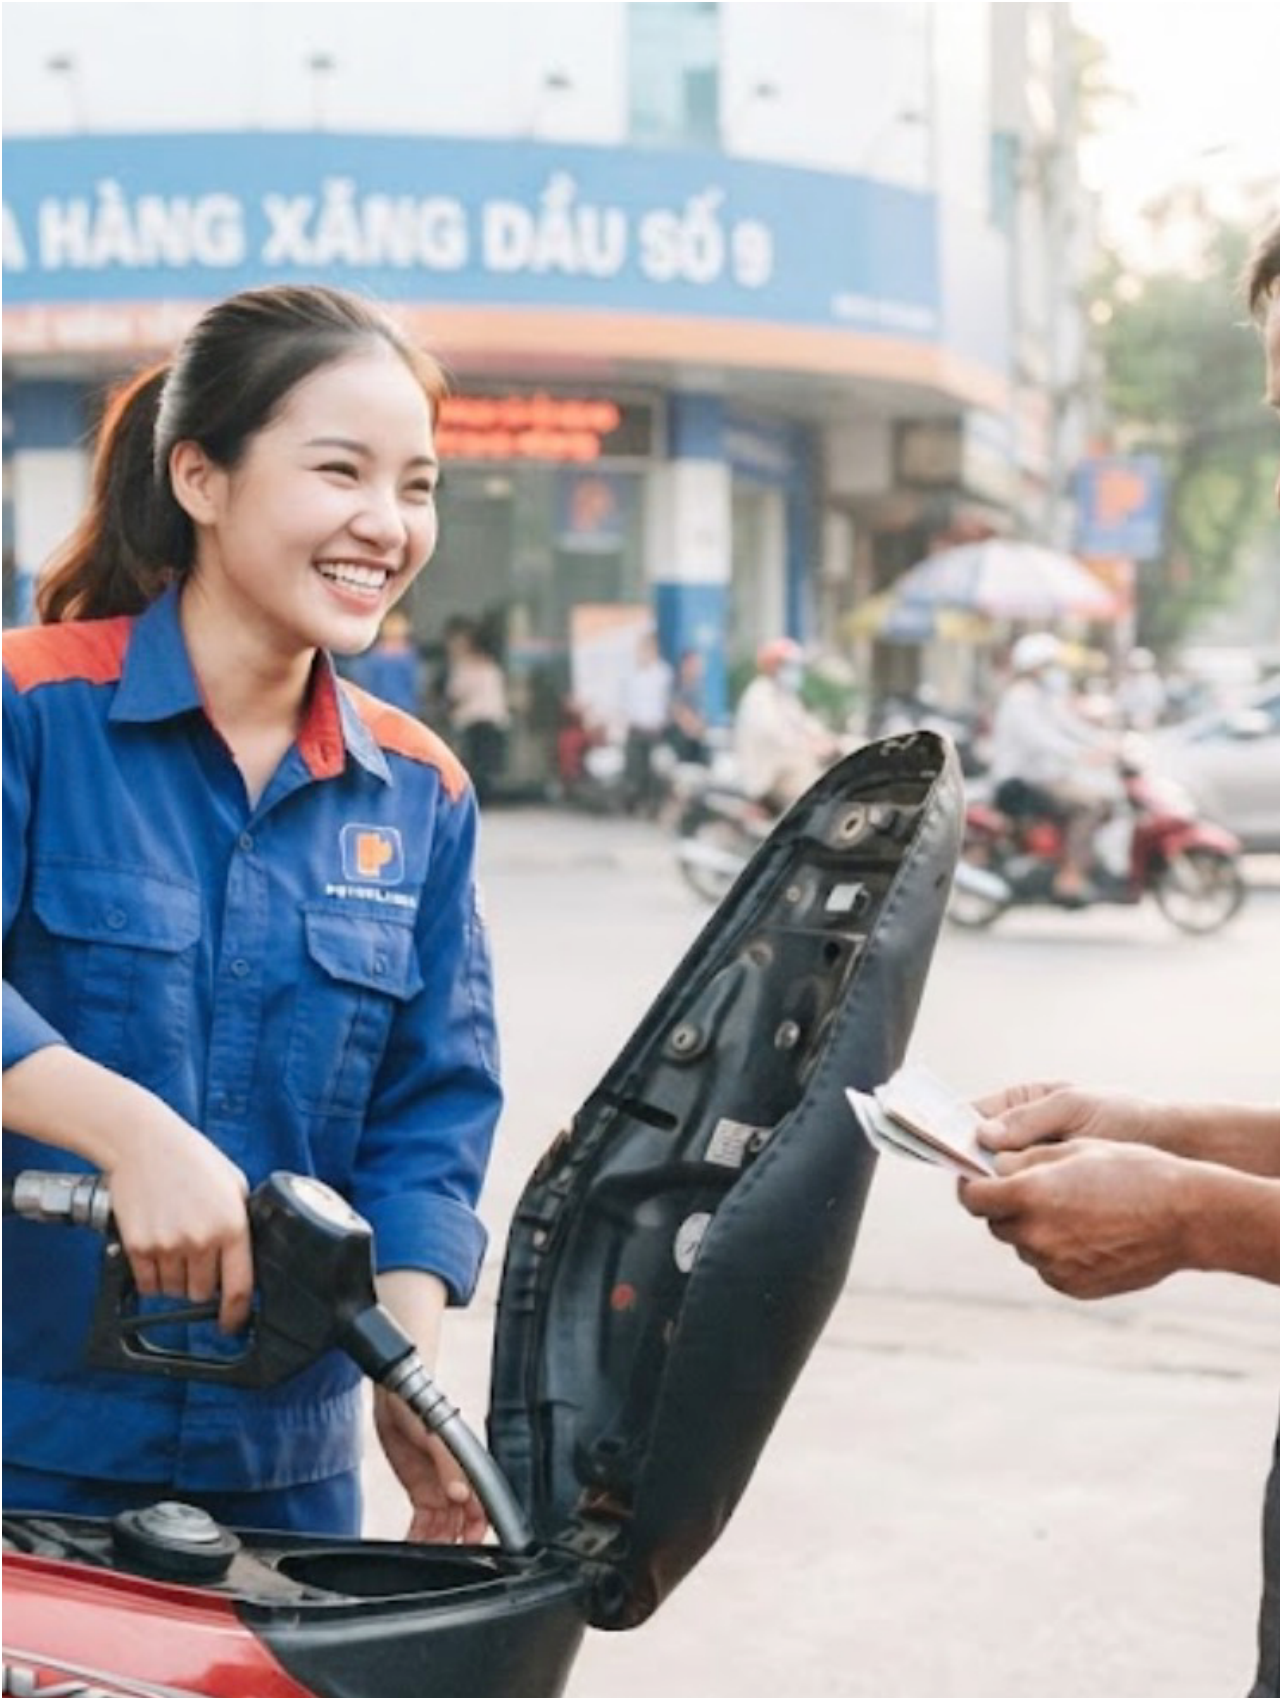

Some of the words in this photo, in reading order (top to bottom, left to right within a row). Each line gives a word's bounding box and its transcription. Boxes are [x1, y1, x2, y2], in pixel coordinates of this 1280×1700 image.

[39, 177, 245, 269] HÀNG
[262, 175, 466, 270] XĂNG
[638, 188, 725, 283] SỐ
